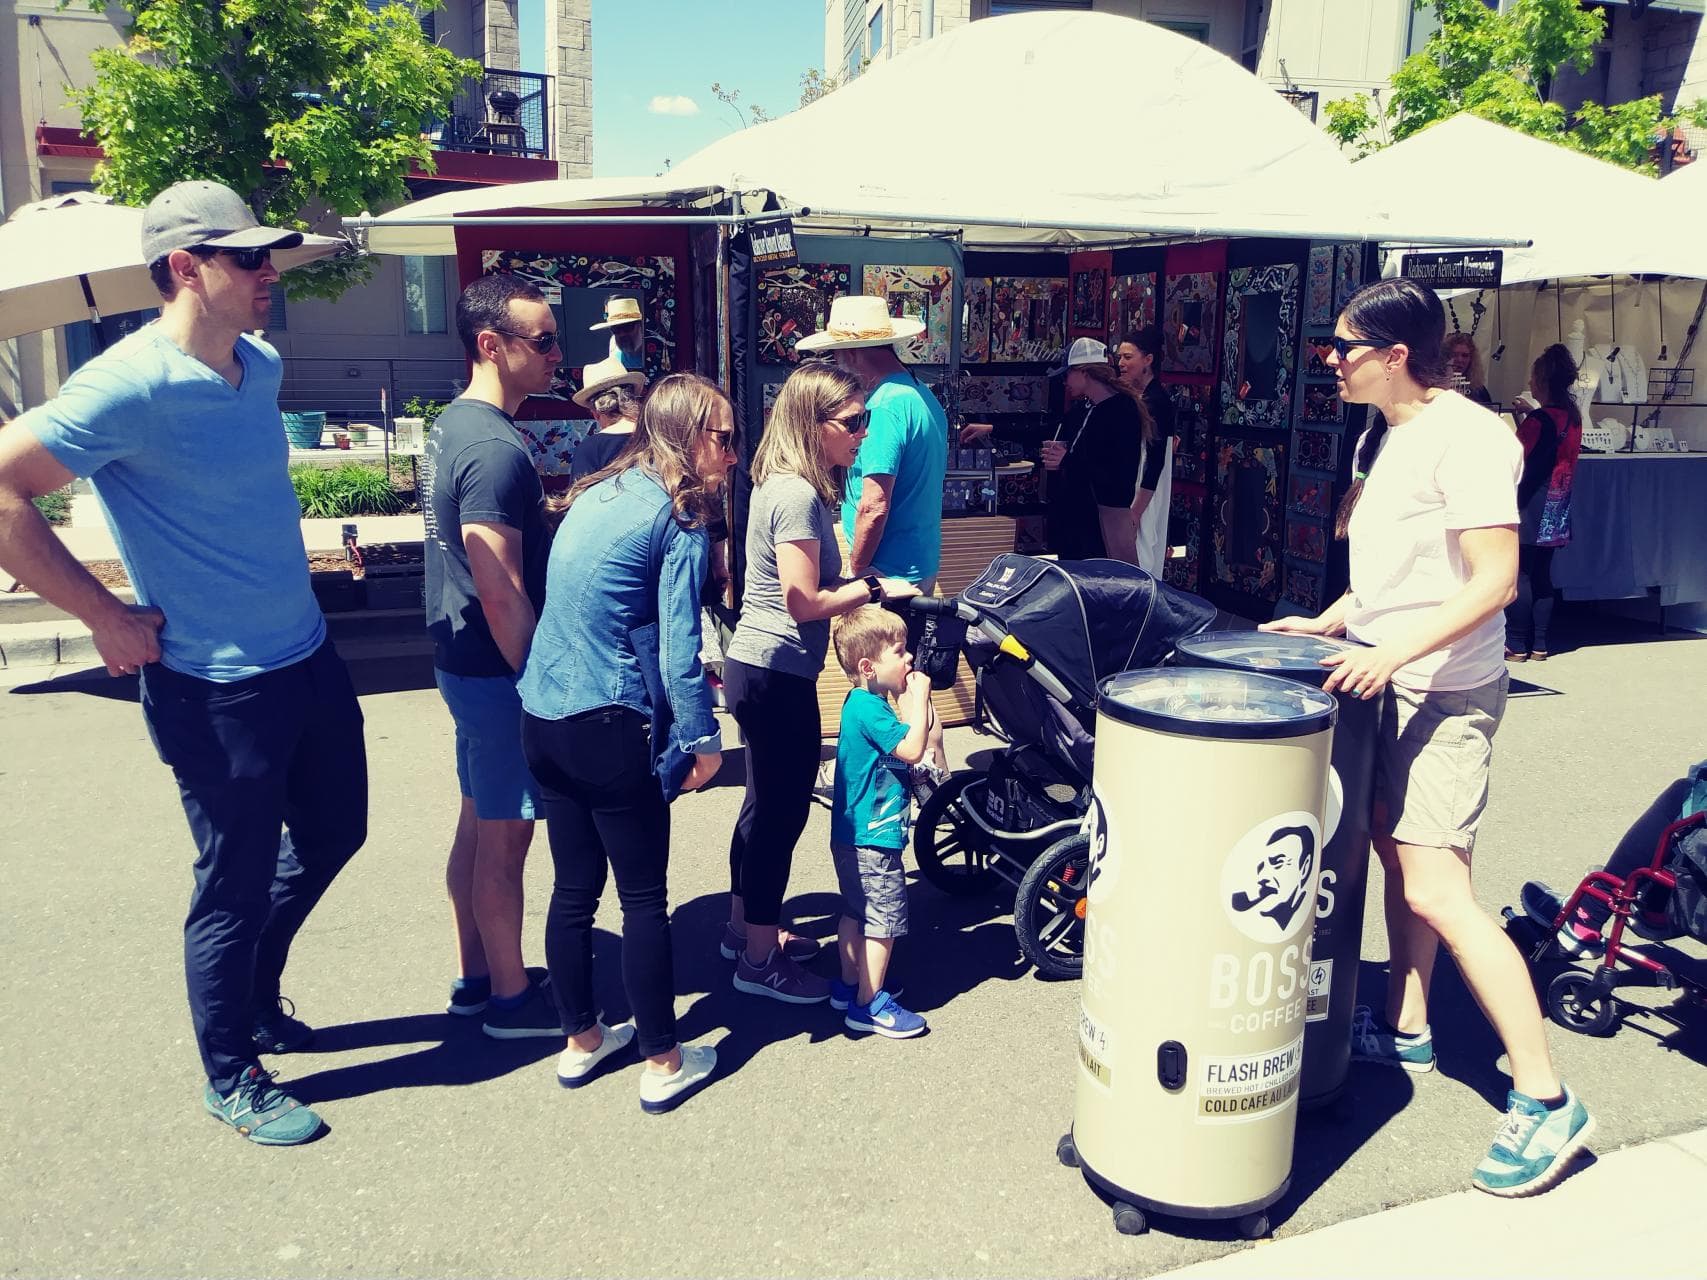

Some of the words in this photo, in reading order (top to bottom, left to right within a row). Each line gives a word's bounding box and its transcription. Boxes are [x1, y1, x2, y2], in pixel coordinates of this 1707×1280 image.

[1408, 258, 1437, 278] Rediscover
[1438, 257, 1461, 278] Reinvent
[1315, 869, 1337, 919] S
[1209, 935, 1312, 1009] BOSS
[1230, 998, 1302, 1034] COFFEE
[1307, 999, 1317, 1012] EE
[1087, 1053, 1101, 1077] LAIT
[1207, 1061, 1259, 1083] FLASH
[1263, 1046, 1295, 1078] BREW
[1206, 1086, 1242, 1095] BREWED
[1244, 1084, 1259, 1092] HOT
[1265, 1073, 1289, 1089] CHILLED
[1205, 1099, 1238, 1113] COLD
[1269, 1087, 1282, 1105] AU
